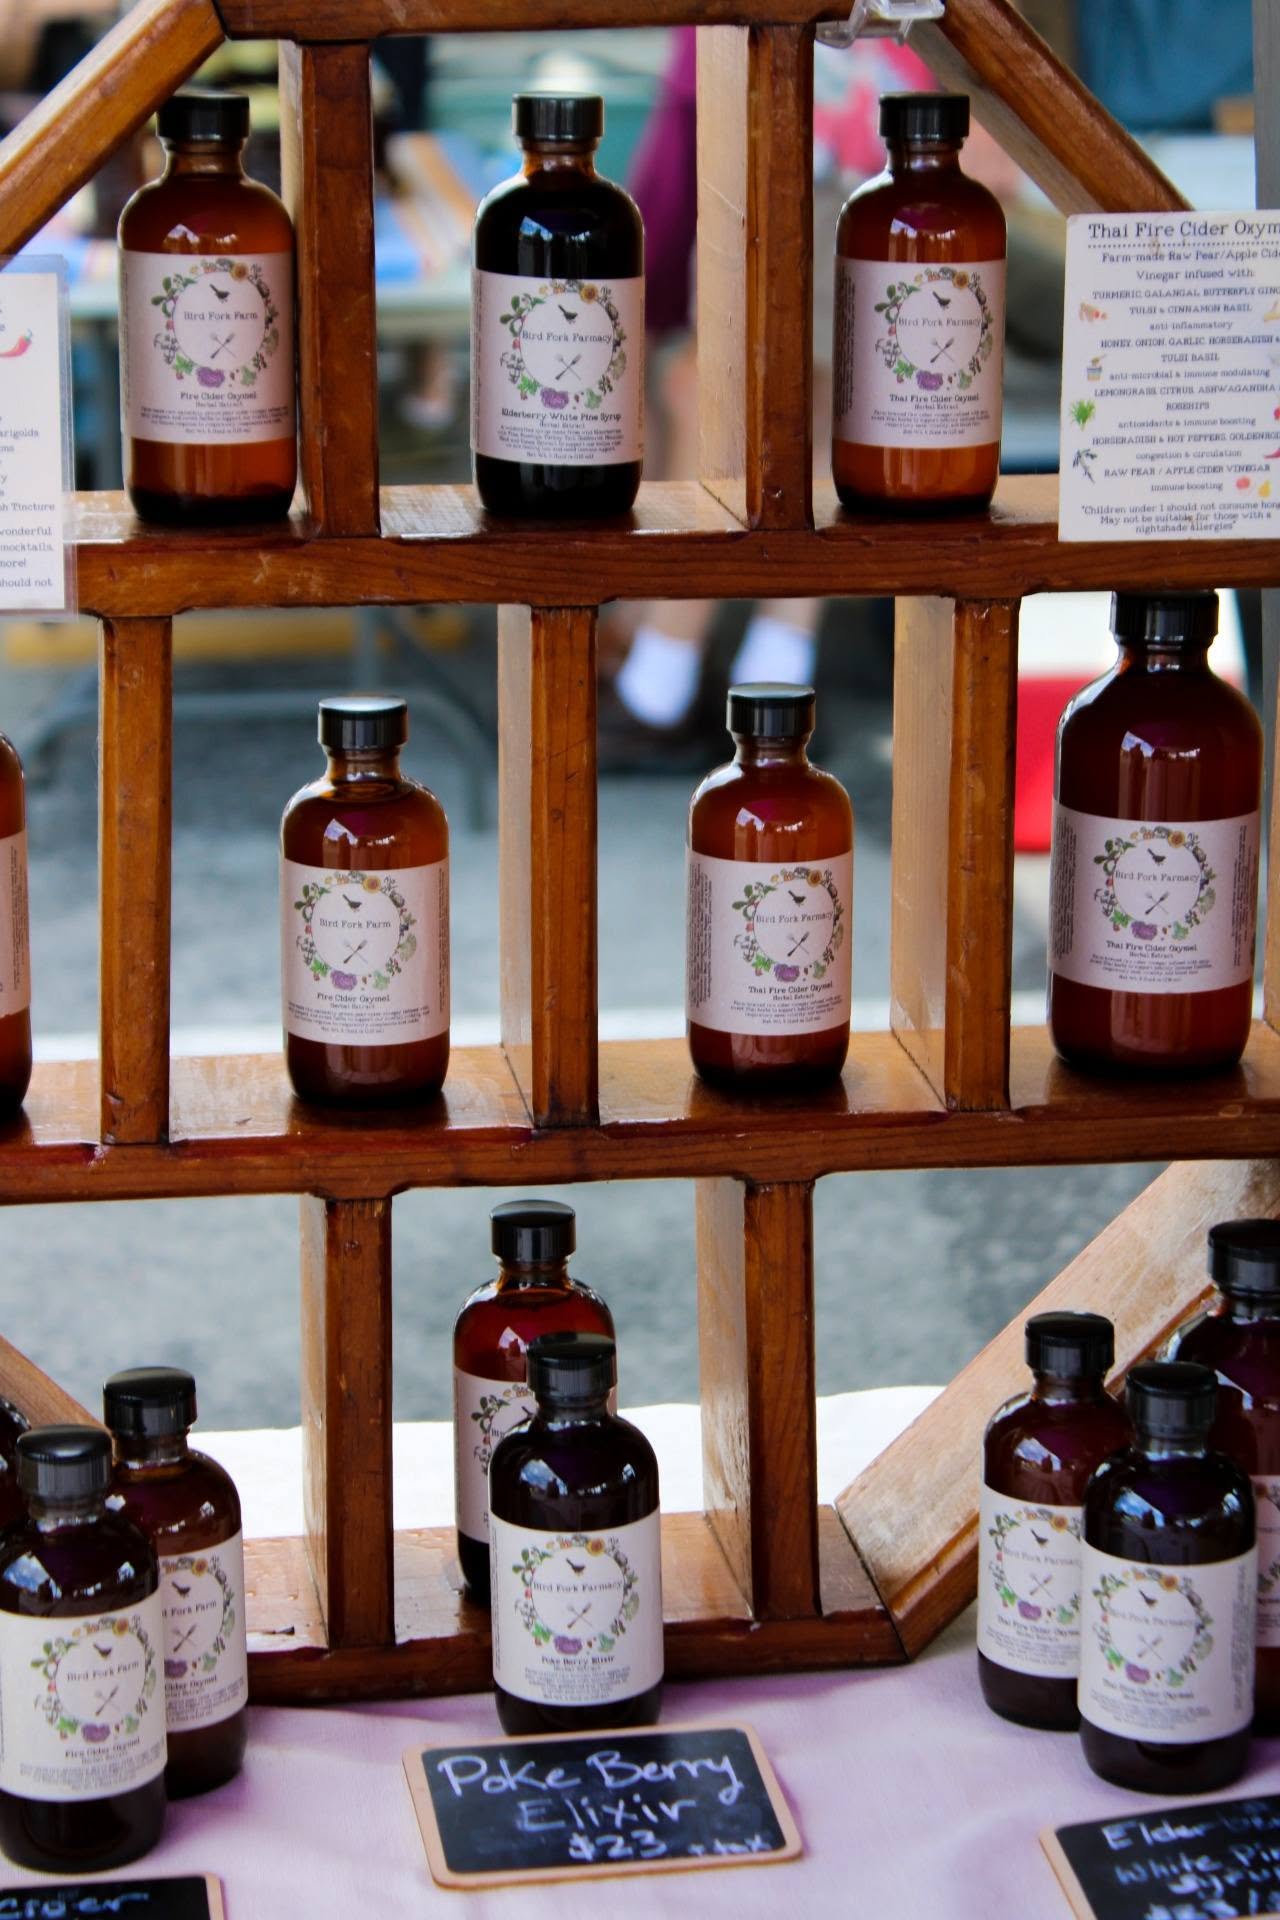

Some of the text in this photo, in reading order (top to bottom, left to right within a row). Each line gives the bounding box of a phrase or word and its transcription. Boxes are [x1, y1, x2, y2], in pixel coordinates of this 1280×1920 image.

[1088, 223, 1128, 239] Thai
[1136, 222, 1175, 237] Fire
[1180, 220, 1229, 237] Cider
[1168, 250, 1191, 261] Raw
[1196, 249, 1258, 261] Pear/Apple
[1137, 270, 1179, 282] Vinegar
[1185, 269, 1224, 279] infused
[1168, 304, 1220, 313] CINNAMON
[1223, 303, 1253, 312] BASIL
[208, 311, 231, 321] Fork
[234, 311, 258, 320] Farm
[522, 330, 613, 345] Bird Fork Farmacy
[501, 407, 546, 420] Elderberry
[549, 412, 578, 421] White
[1104, 468, 1128, 477] RAW
[1197, 464, 1224, 473] CIDER
[1226, 463, 1271, 473] VINEGAR
[1200, 503, 1216, 511] not
[1101, 515, 1120, 525] May
[1123, 515, 1140, 524] not
[1115, 871, 1199, 884] Bird Fork Farmacy
[319, 918, 391, 928] Bird Fork Farm
[756, 911, 834, 923] Bird Fork Farmacy
[1105, 940, 1123, 950] Thai
[1126, 942, 1142, 951] Fire
[748, 986, 766, 994] Thai
[768, 986, 786, 994] Fire
[317, 992, 390, 1003] Fire Cider Oxymel
[438, 1750, 744, 1805] Poke Berry
[517, 1793, 697, 1833] Elixir
[568, 1829, 668, 1861] $23
